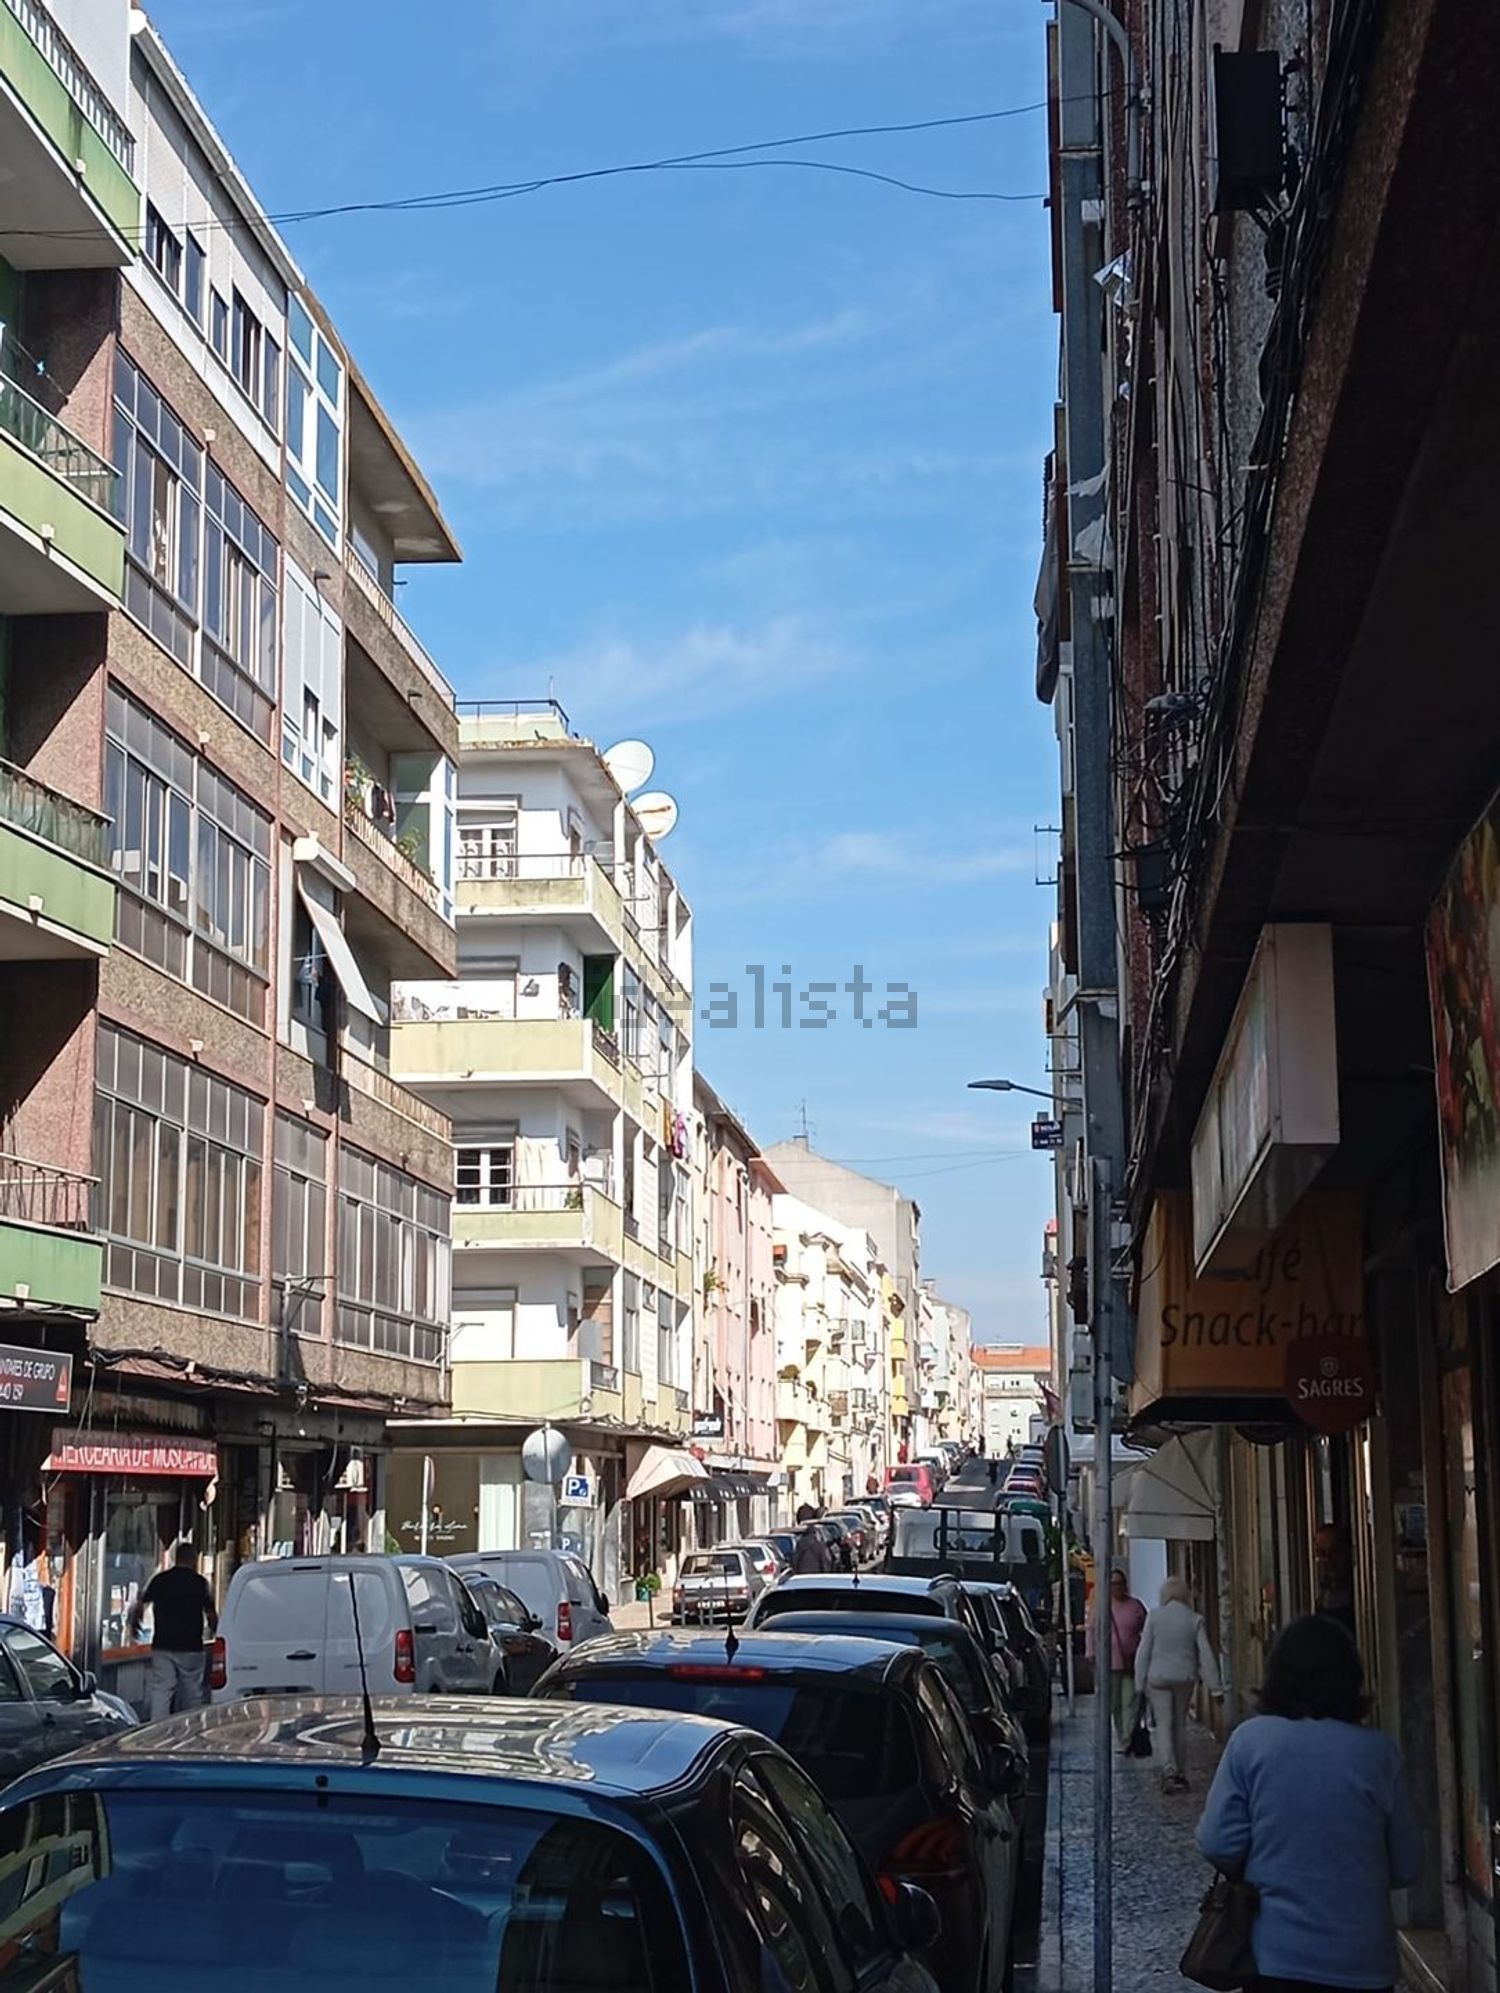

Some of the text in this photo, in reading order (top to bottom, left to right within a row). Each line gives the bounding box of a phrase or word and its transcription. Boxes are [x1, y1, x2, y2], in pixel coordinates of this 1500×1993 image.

[1161, 1302, 1365, 1347] Snack-bar
[1298, 1378, 1365, 1400] SAGRES
[132, 1437, 150, 1467] DE
[568, 1479, 580, 1496] P
